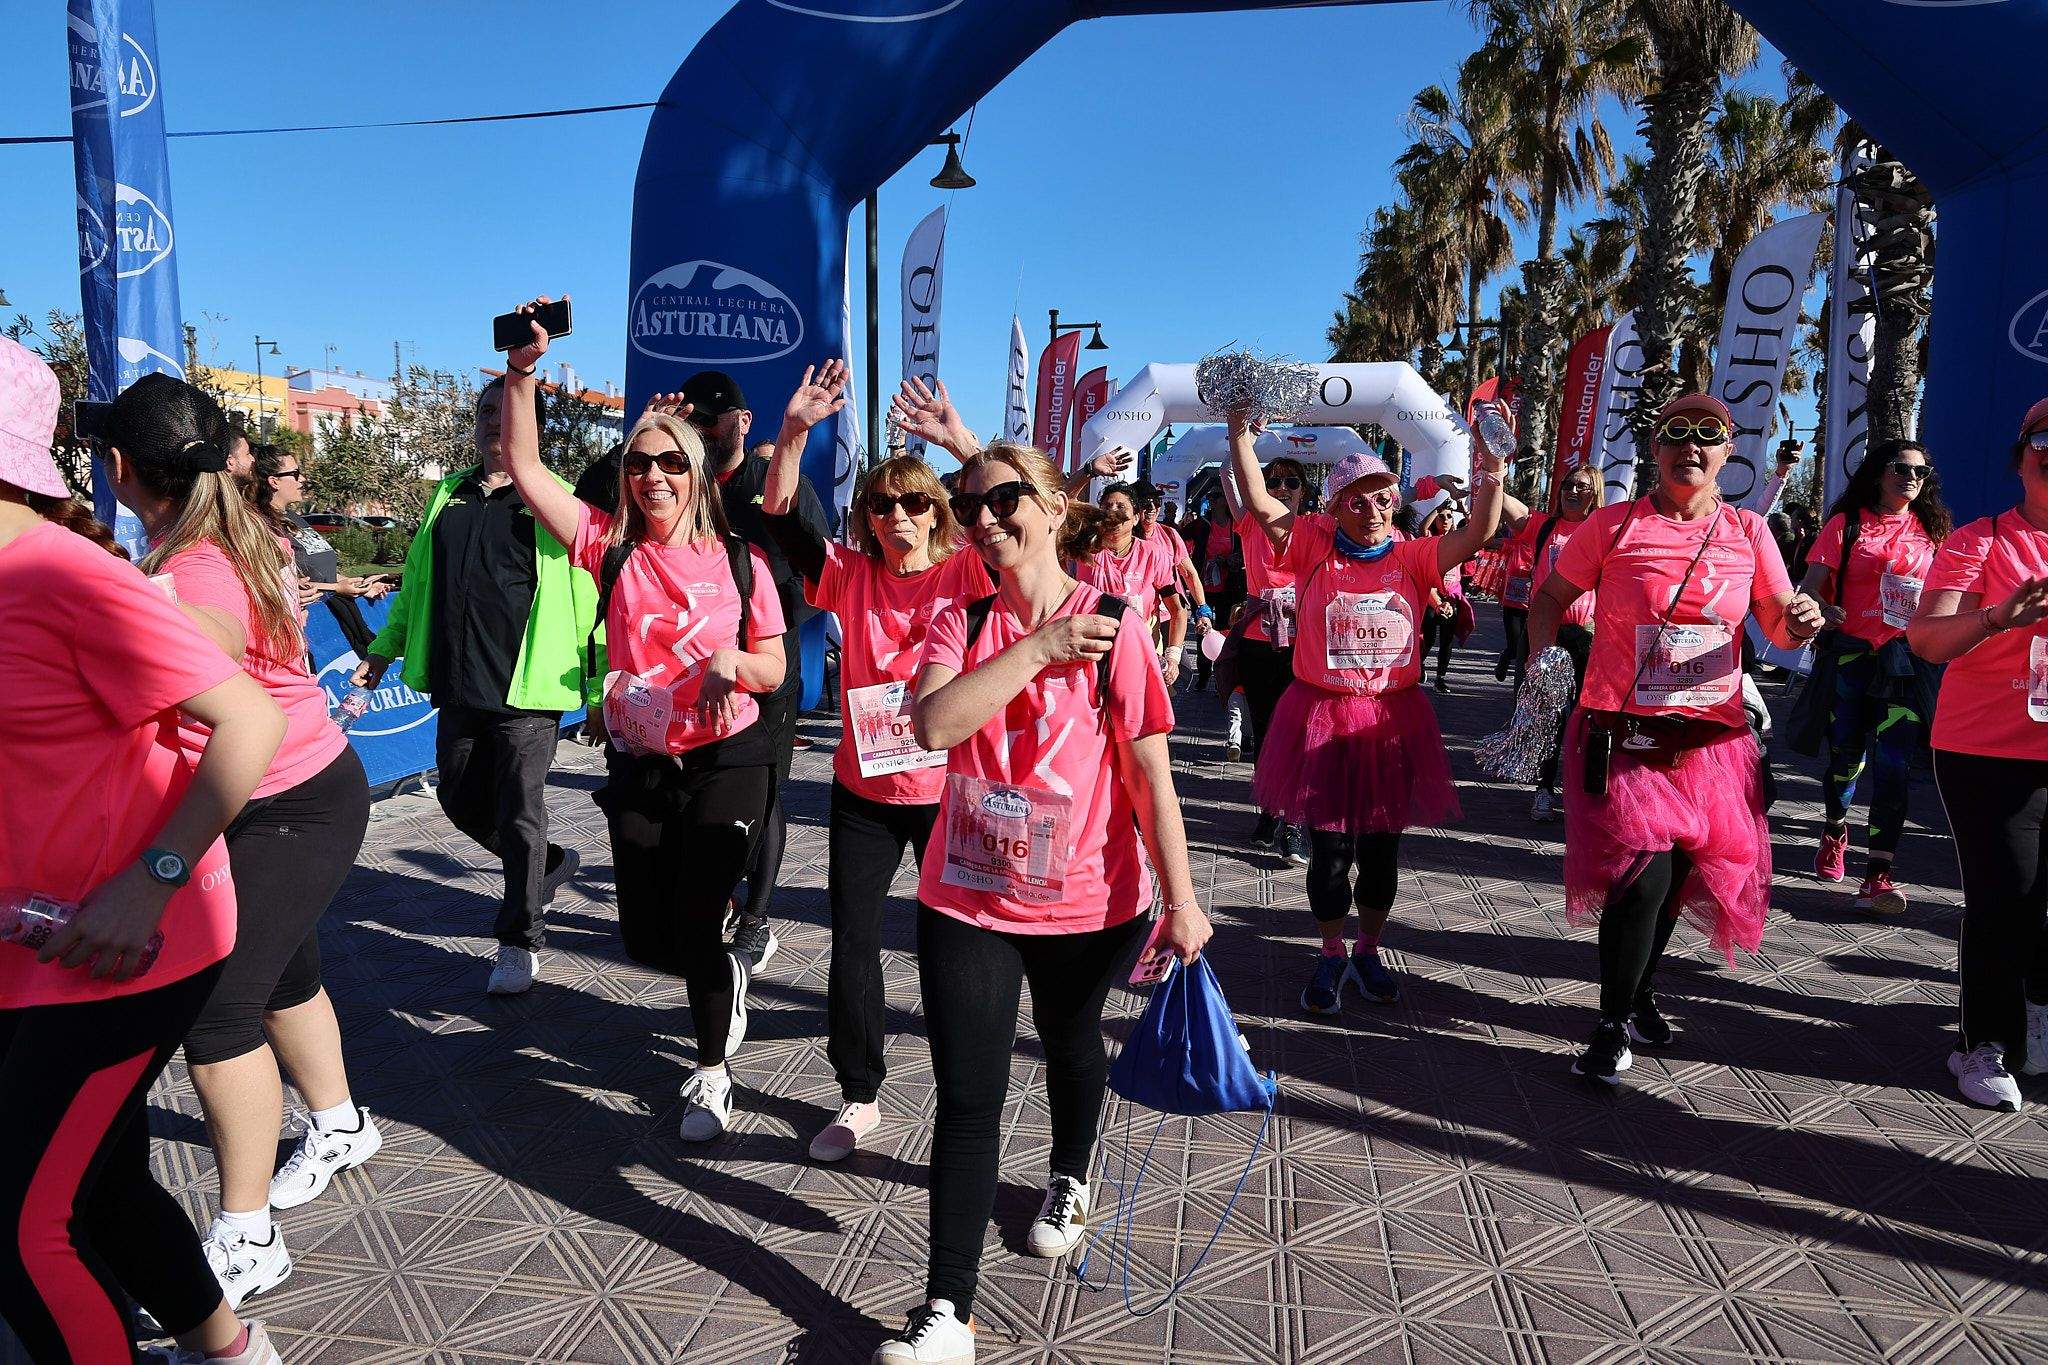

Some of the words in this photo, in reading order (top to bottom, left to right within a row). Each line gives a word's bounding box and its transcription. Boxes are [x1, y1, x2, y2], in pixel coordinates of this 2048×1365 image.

[653, 296, 711, 306] CENTRAL
[718, 297, 785, 314] LECHERA
[634, 299, 791, 345] ASTURIANA
[1045, 358, 1067, 444] Santander
[1571, 352, 1603, 447] Santander
[1106, 410, 1152, 422] OYSHO
[1396, 410, 1445, 422] OYSHO
[1901, 599, 1918, 611] 016
[1356, 627, 1388, 640] 016
[1669, 661, 1705, 675] 016
[625, 717, 648, 739] 016
[891, 721, 915, 737] 01
[1633, 734, 1656, 746] NIKE
[984, 797, 1029, 814] ASTURIANA
[982, 834, 1029, 858] 016
[991, 857, 1012, 869] 9300
[957, 870, 994, 885] OYSHO
